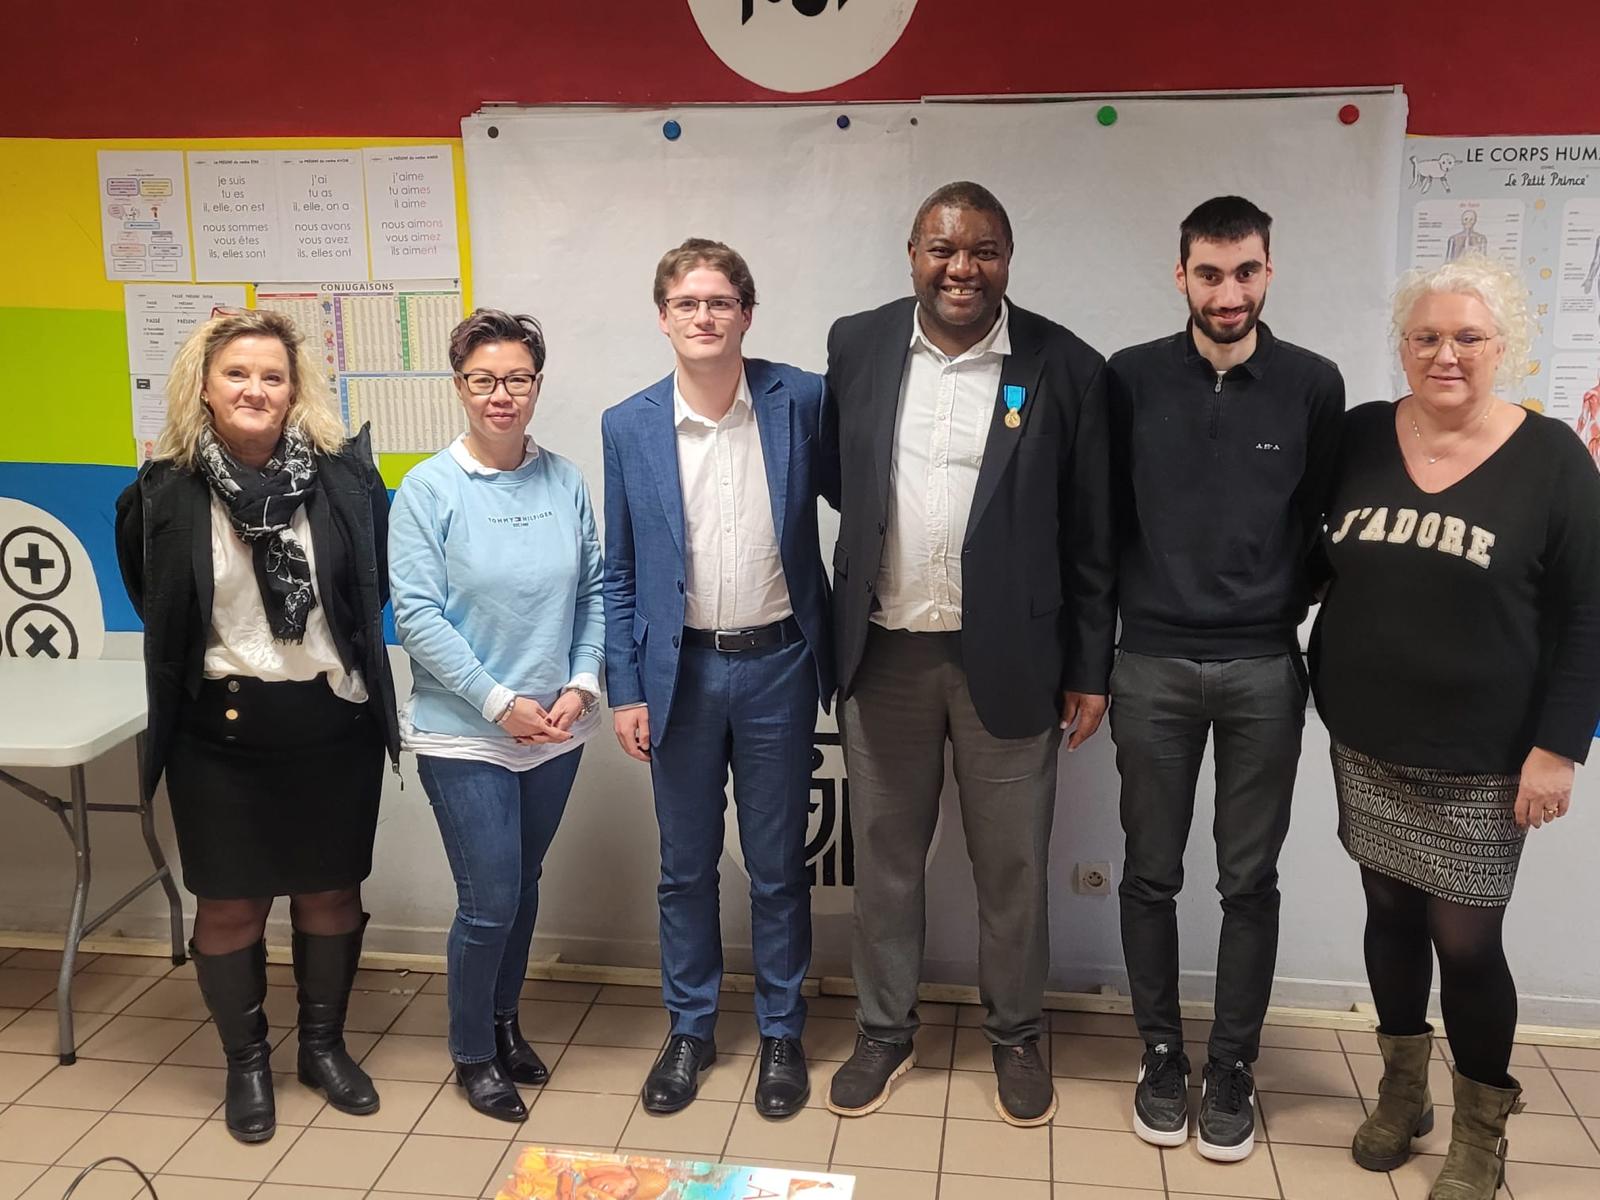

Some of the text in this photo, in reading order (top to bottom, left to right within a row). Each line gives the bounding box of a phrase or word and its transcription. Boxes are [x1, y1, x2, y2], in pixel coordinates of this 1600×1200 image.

[1466, 146, 1600, 162] LE CORPS HUM
[217, 176, 246, 187] je suis
[311, 174, 328, 186] j'ai
[393, 172, 424, 184] j'aime
[1505, 171, 1586, 186] Le Petit Prince
[221, 189, 245, 198] tu es
[308, 188, 333, 197] tu as
[389, 185, 431, 195] tu aimes
[235, 204, 248, 212] on
[251, 203, 265, 212] est
[326, 203, 339, 211] on
[342, 203, 350, 211] a
[394, 199, 426, 208] il aime
[202, 223, 269, 232] nous sommes
[294, 223, 351, 232] nous avons
[381, 219, 443, 229] nous aimons
[214, 237, 236, 245] vous
[299, 236, 349, 244] vous avez
[385, 233, 441, 242] vous aimez
[222, 248, 244, 258] elles
[246, 249, 266, 258] sont
[311, 247, 333, 257] elles
[335, 248, 352, 257] ont
[391, 246, 437, 255] ils aiment
[320, 282, 395, 292] CONJUGAISONS
[522, 511, 553, 521] HILFIGER
[1332, 507, 1496, 570] J'ADORE
